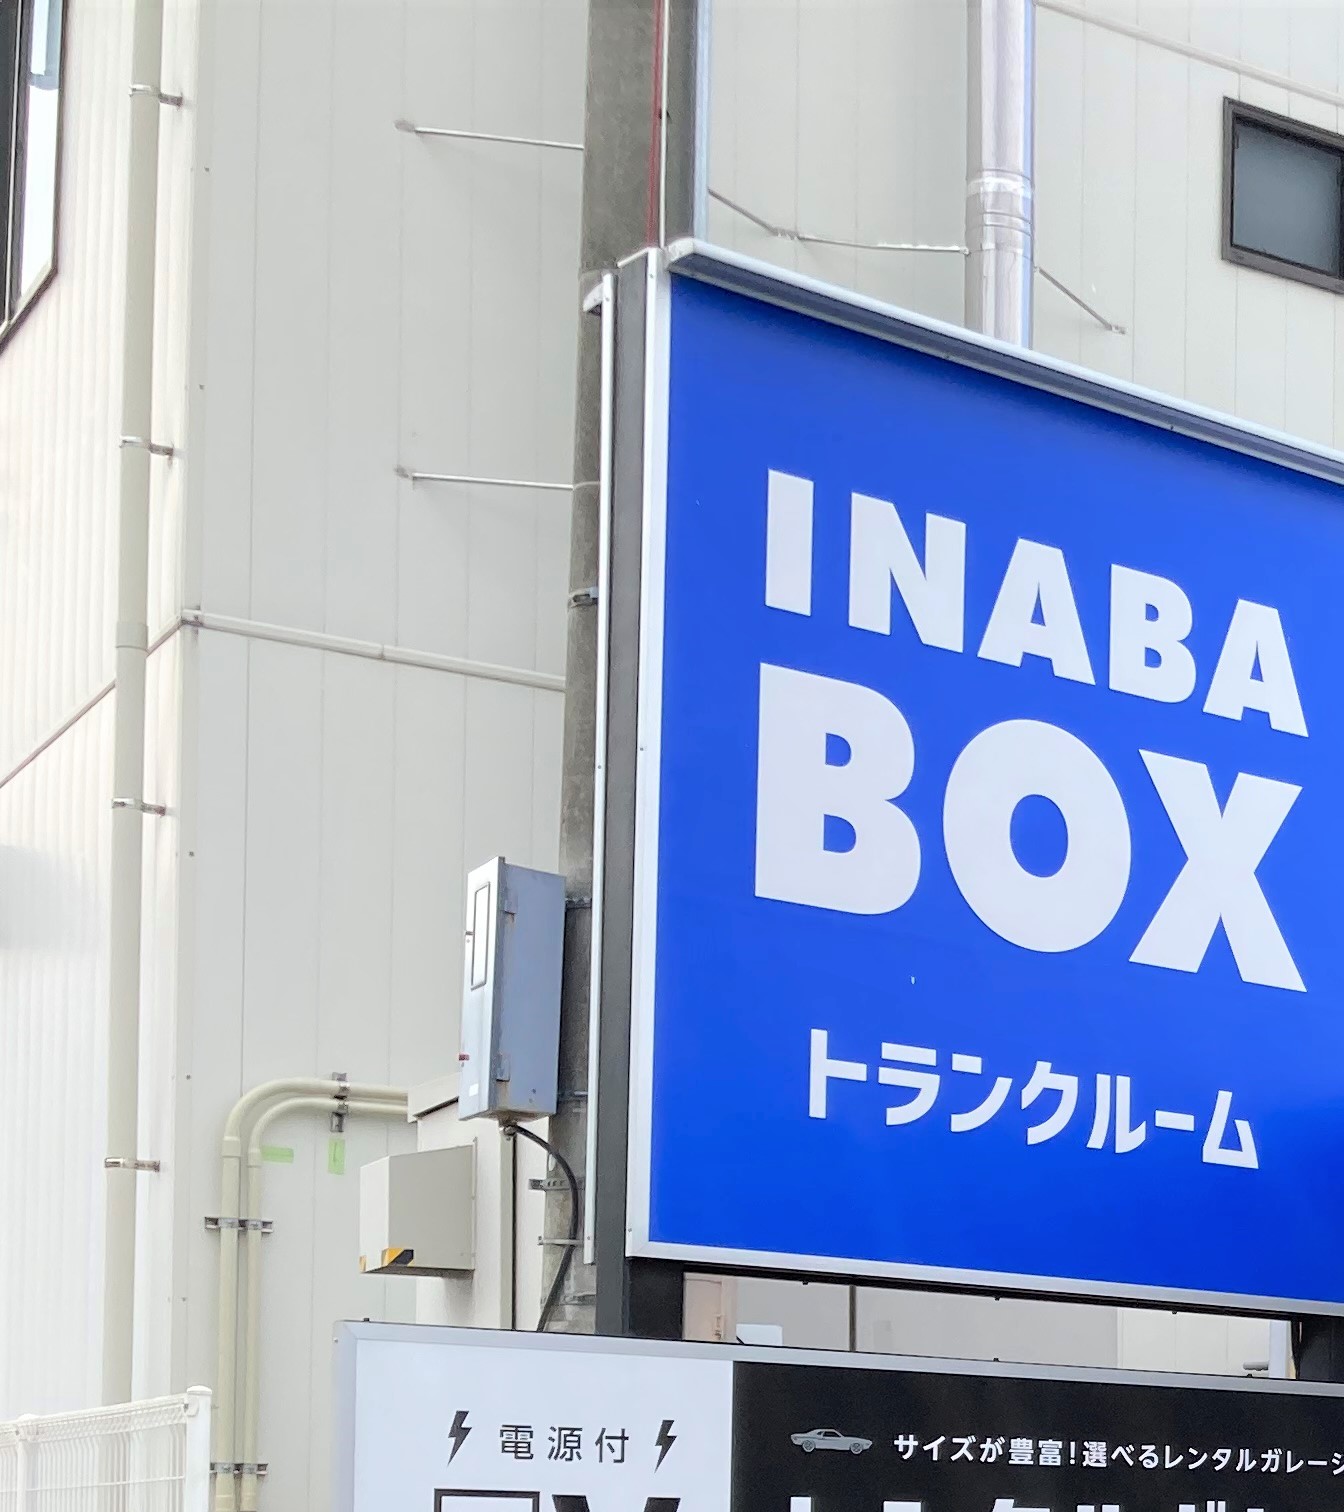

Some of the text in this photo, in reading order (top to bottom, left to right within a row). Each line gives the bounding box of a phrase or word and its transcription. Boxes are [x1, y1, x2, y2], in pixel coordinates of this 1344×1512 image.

[765, 469, 1309, 737] INABA
[755, 662, 1307, 992] BOX
[809, 1028, 1259, 1170] トランクルーム
[499, 1423, 630, 1464] 電源付
